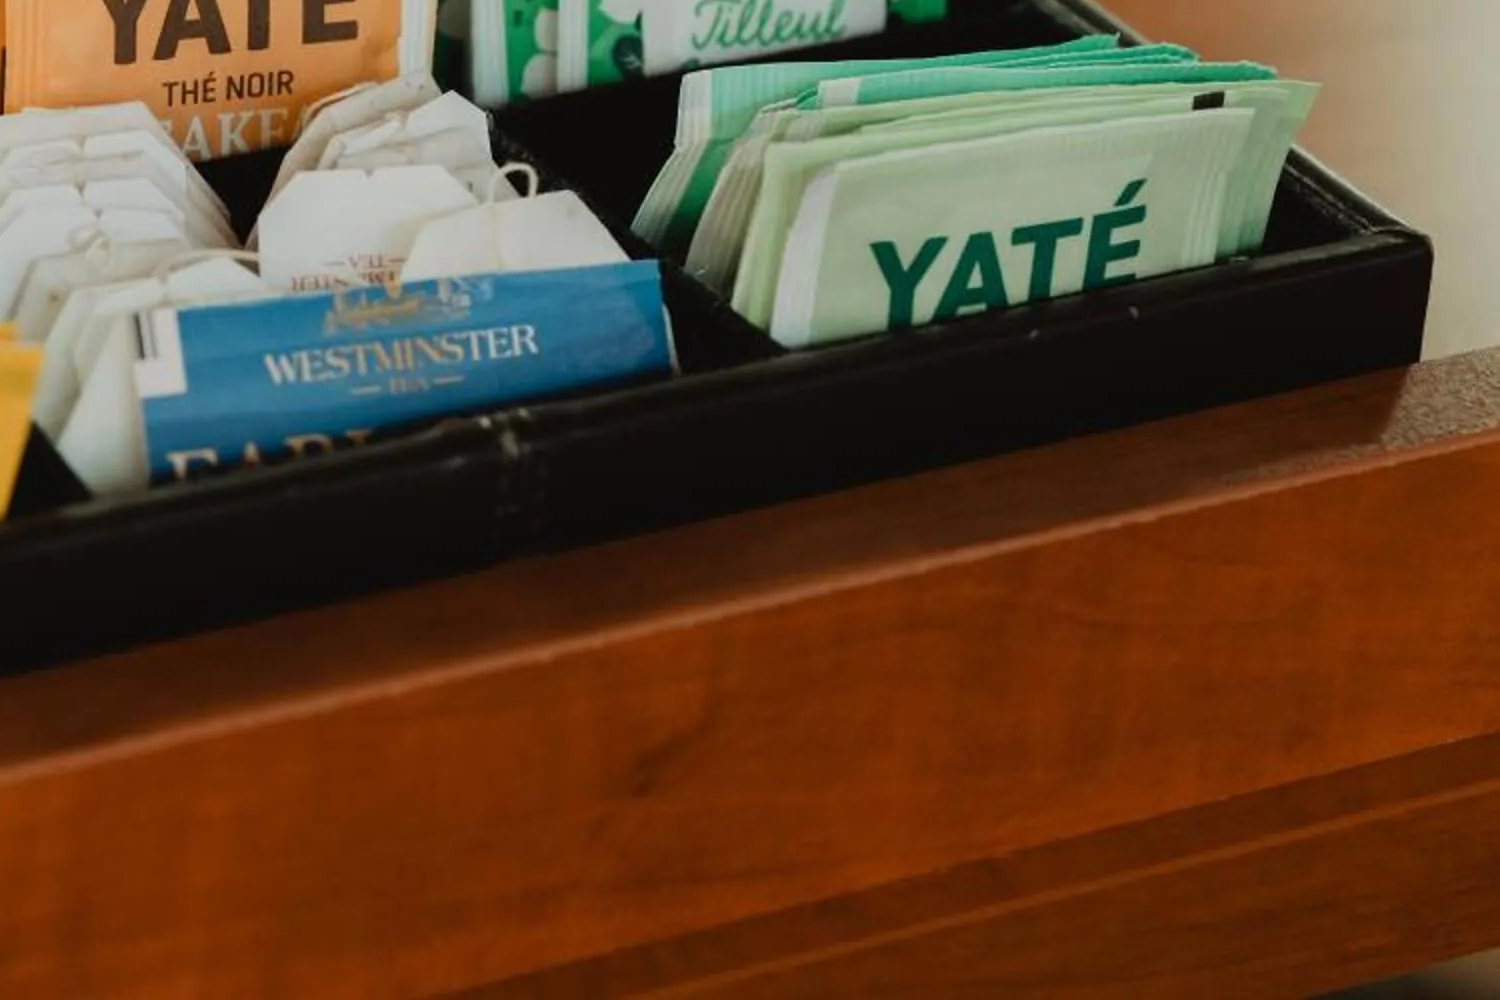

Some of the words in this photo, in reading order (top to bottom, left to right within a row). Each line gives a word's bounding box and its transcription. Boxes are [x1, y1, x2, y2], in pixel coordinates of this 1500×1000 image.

[162, 72, 217, 106] THÉ
[226, 70, 294, 100] NOIR
[870, 177, 1147, 331] YATÉ
[264, 324, 539, 385] WESTMINSTER
